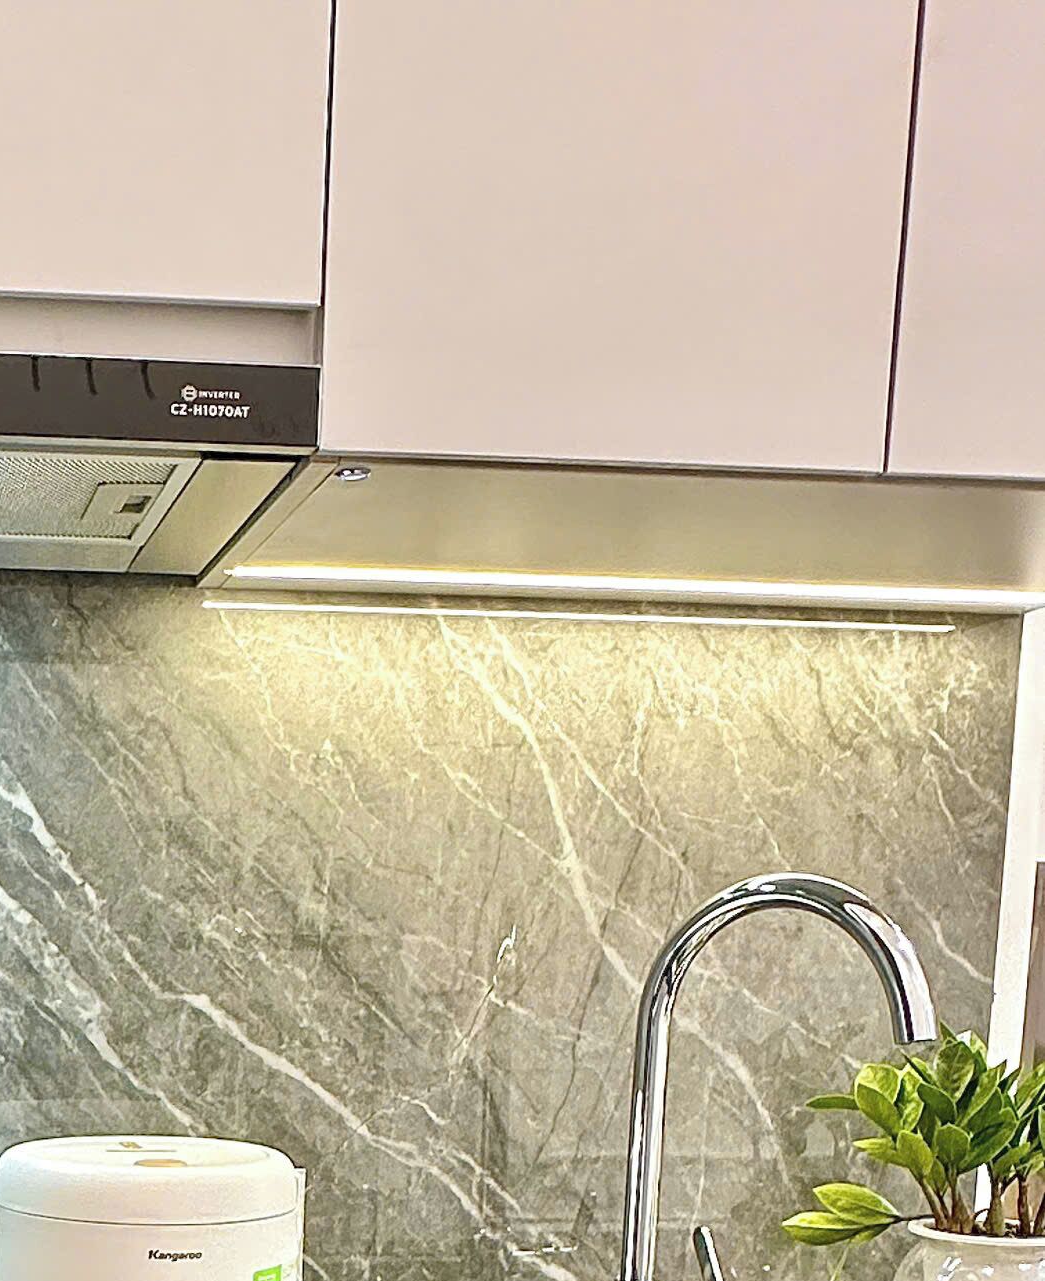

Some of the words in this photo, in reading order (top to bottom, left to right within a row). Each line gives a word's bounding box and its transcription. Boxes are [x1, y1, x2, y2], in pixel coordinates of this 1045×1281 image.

[198, 391, 241, 400] INVERTER
[170, 403, 251, 418] CZ-H1070AT
[148, 1250, 203, 1262] Kangaroo
